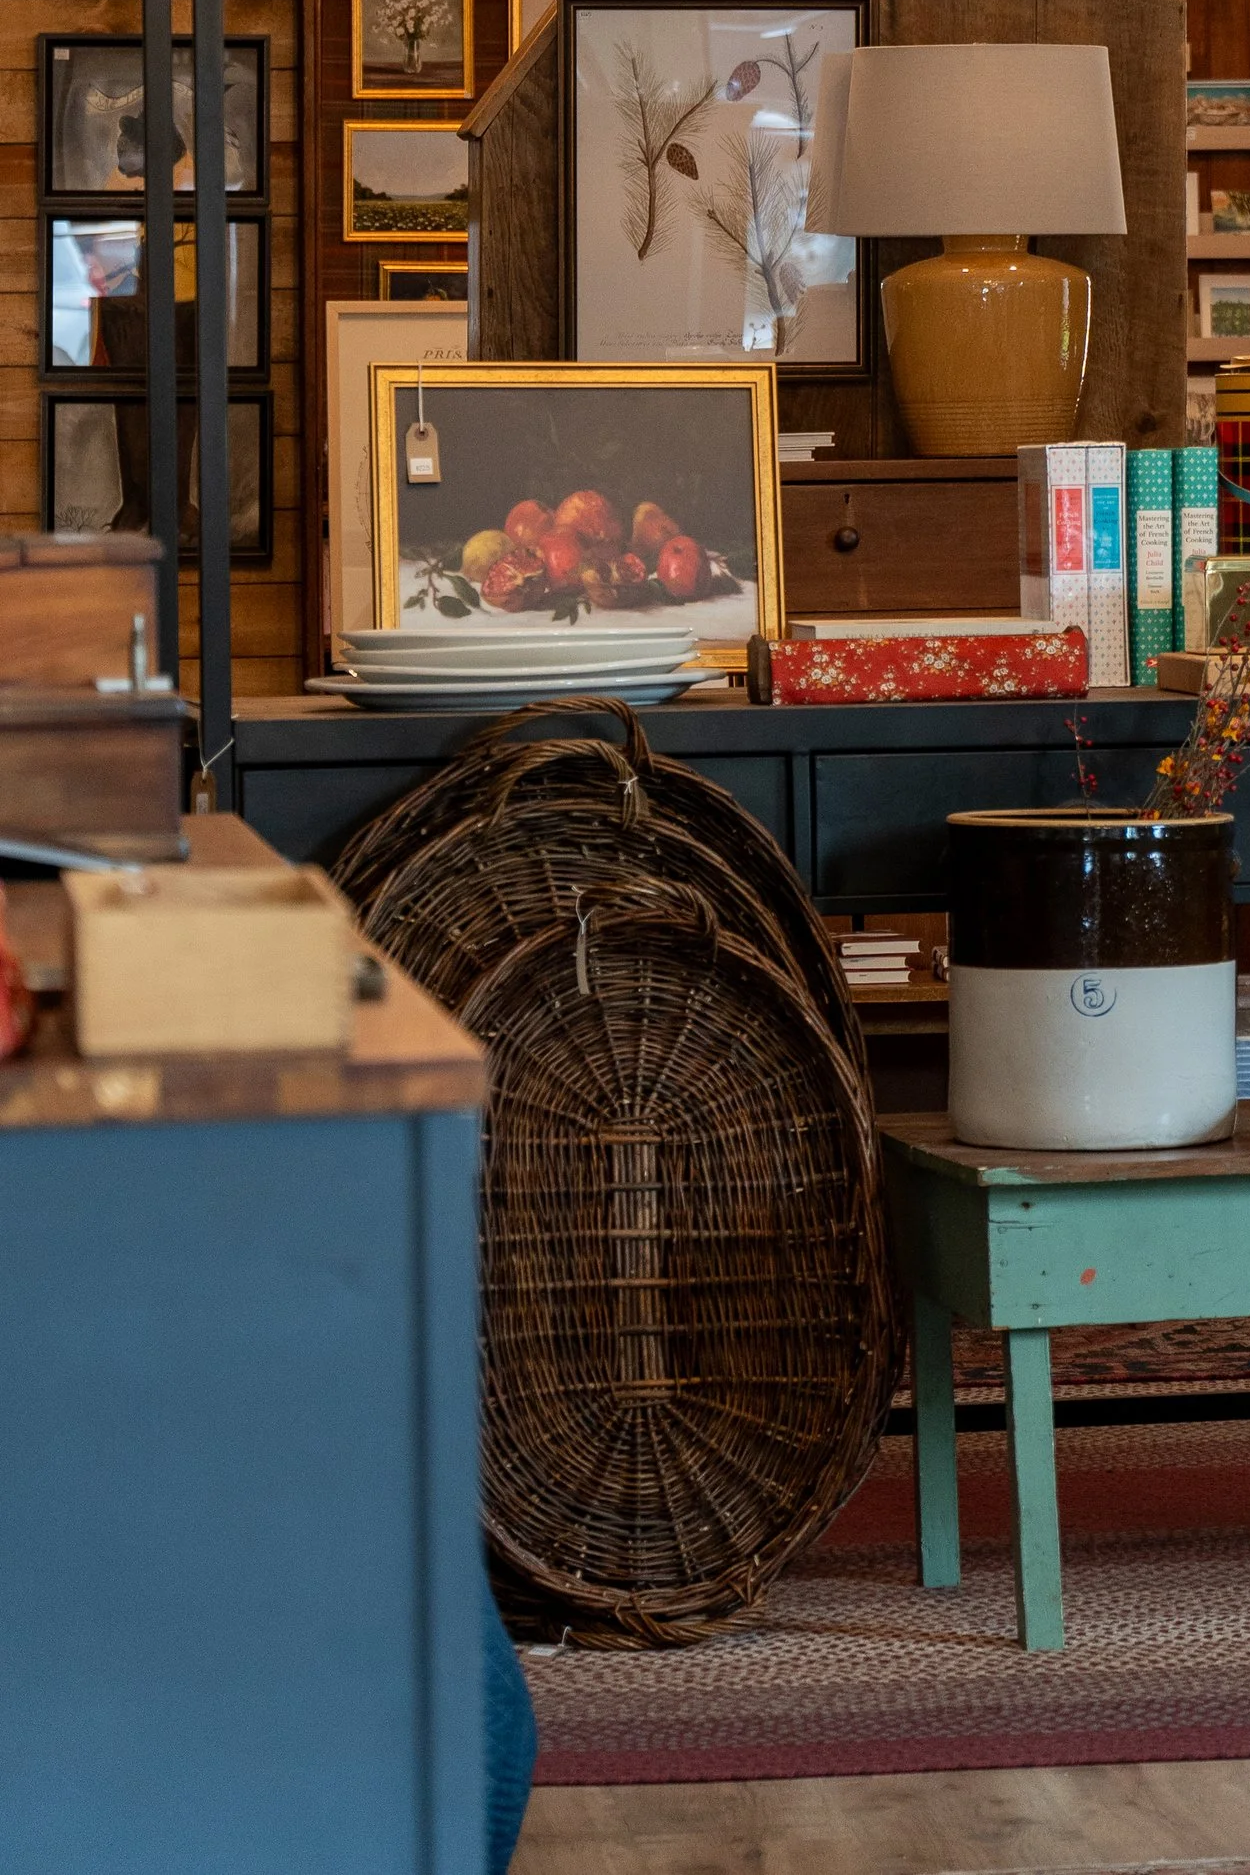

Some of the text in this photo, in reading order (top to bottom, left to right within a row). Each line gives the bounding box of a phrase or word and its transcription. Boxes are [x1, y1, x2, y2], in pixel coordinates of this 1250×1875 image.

[1138, 515, 1169, 523] Mastering
[1183, 512, 1214, 520] Mastering
[1141, 539, 1168, 547] Cooking
[1186, 536, 1213, 544] Cooking
[1147, 550, 1162, 558] Julia
[1083, 979, 1104, 1009] 5
